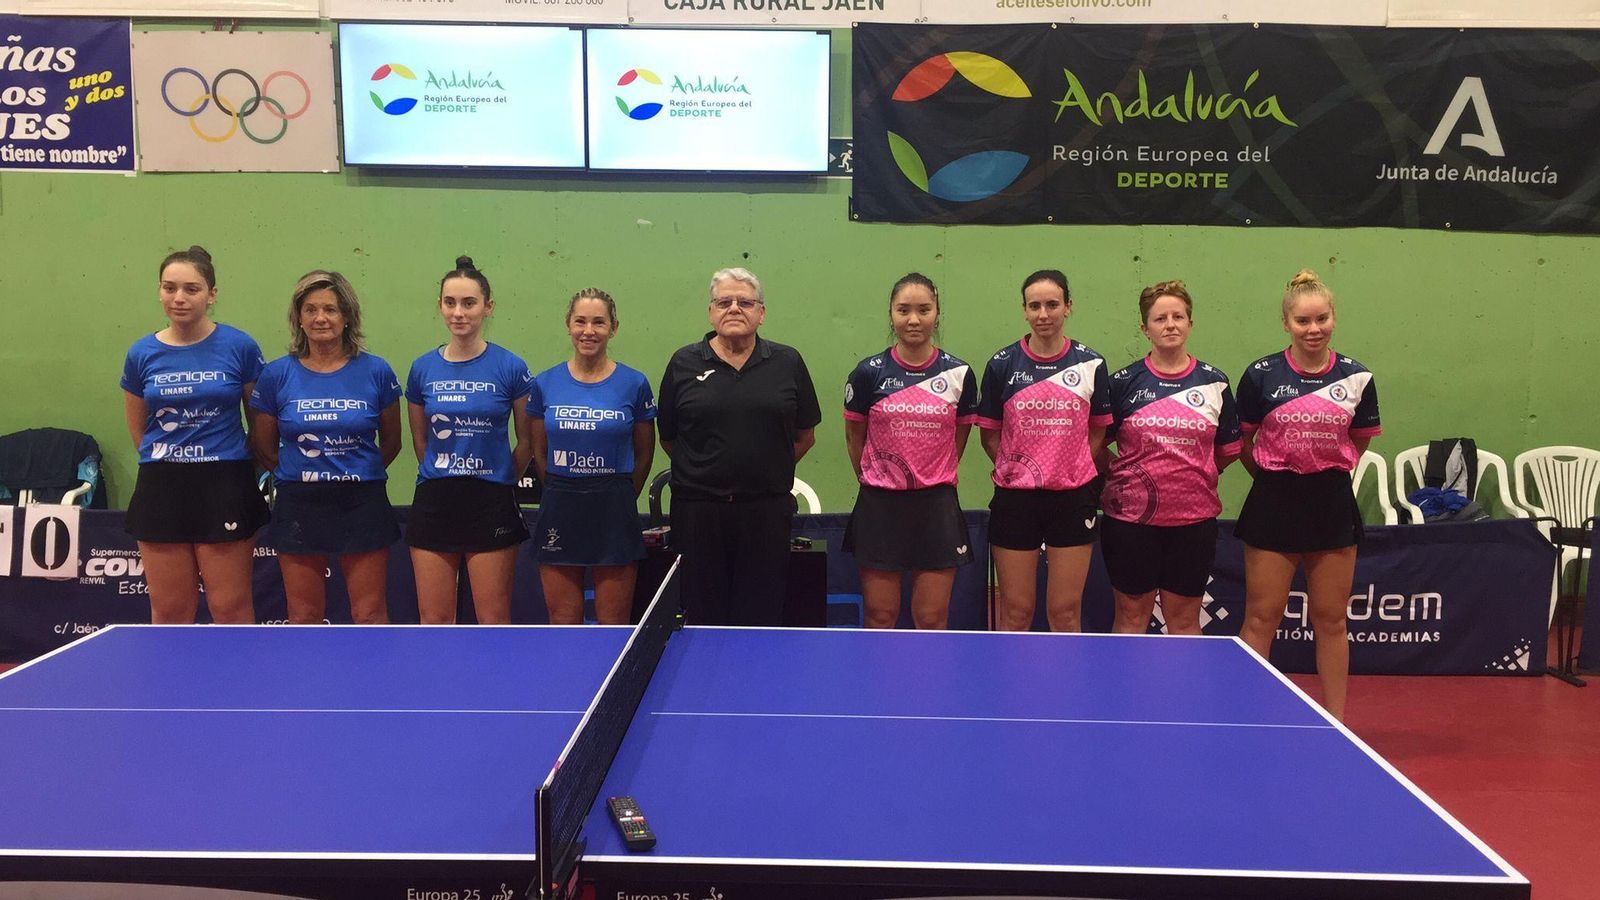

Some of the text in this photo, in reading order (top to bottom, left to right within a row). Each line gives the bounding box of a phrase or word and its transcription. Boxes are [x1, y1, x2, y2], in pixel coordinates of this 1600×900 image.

[69, 71, 113, 90] uno
[425, 69, 506, 91] Andalucía
[670, 74, 751, 96] Andalucía
[64, 85, 126, 112] y dos
[424, 94, 507, 105] Región Europea del
[669, 99, 752, 109] Región Europea del
[1051, 67, 1298, 128] Andalucía
[424, 104, 477, 113] DEPORTE
[669, 108, 721, 118] DEPORTE
[1, 143, 46, 163] tiene
[1052, 144, 1271, 167] Región Europea del
[1117, 171, 1229, 190] DEPORTE
[1375, 163, 1558, 184] Junta de Andalucía
[160, 386, 193, 397] LINARES
[426, 379, 496, 394] Tecnigen
[290, 398, 368, 413] Tecnigen
[549, 404, 626, 422] Tecnigen
[303, 413, 338, 421] LINARES
[906, 420, 942, 429] mazda
[1036, 418, 1072, 426] mazda
[559, 421, 597, 431] LINARES
[1156, 435, 1196, 446] mazda
[164, 442, 205, 459] Jaén
[449, 453, 483, 469] Jaén
[568, 451, 605, 468] Jaén
[79, 577, 106, 585] RENVIL
[1347, 630, 1441, 644] ACADEMIAS
[407, 888, 482, 900] Europa 25
[617, 891, 690, 900] Europa 25
